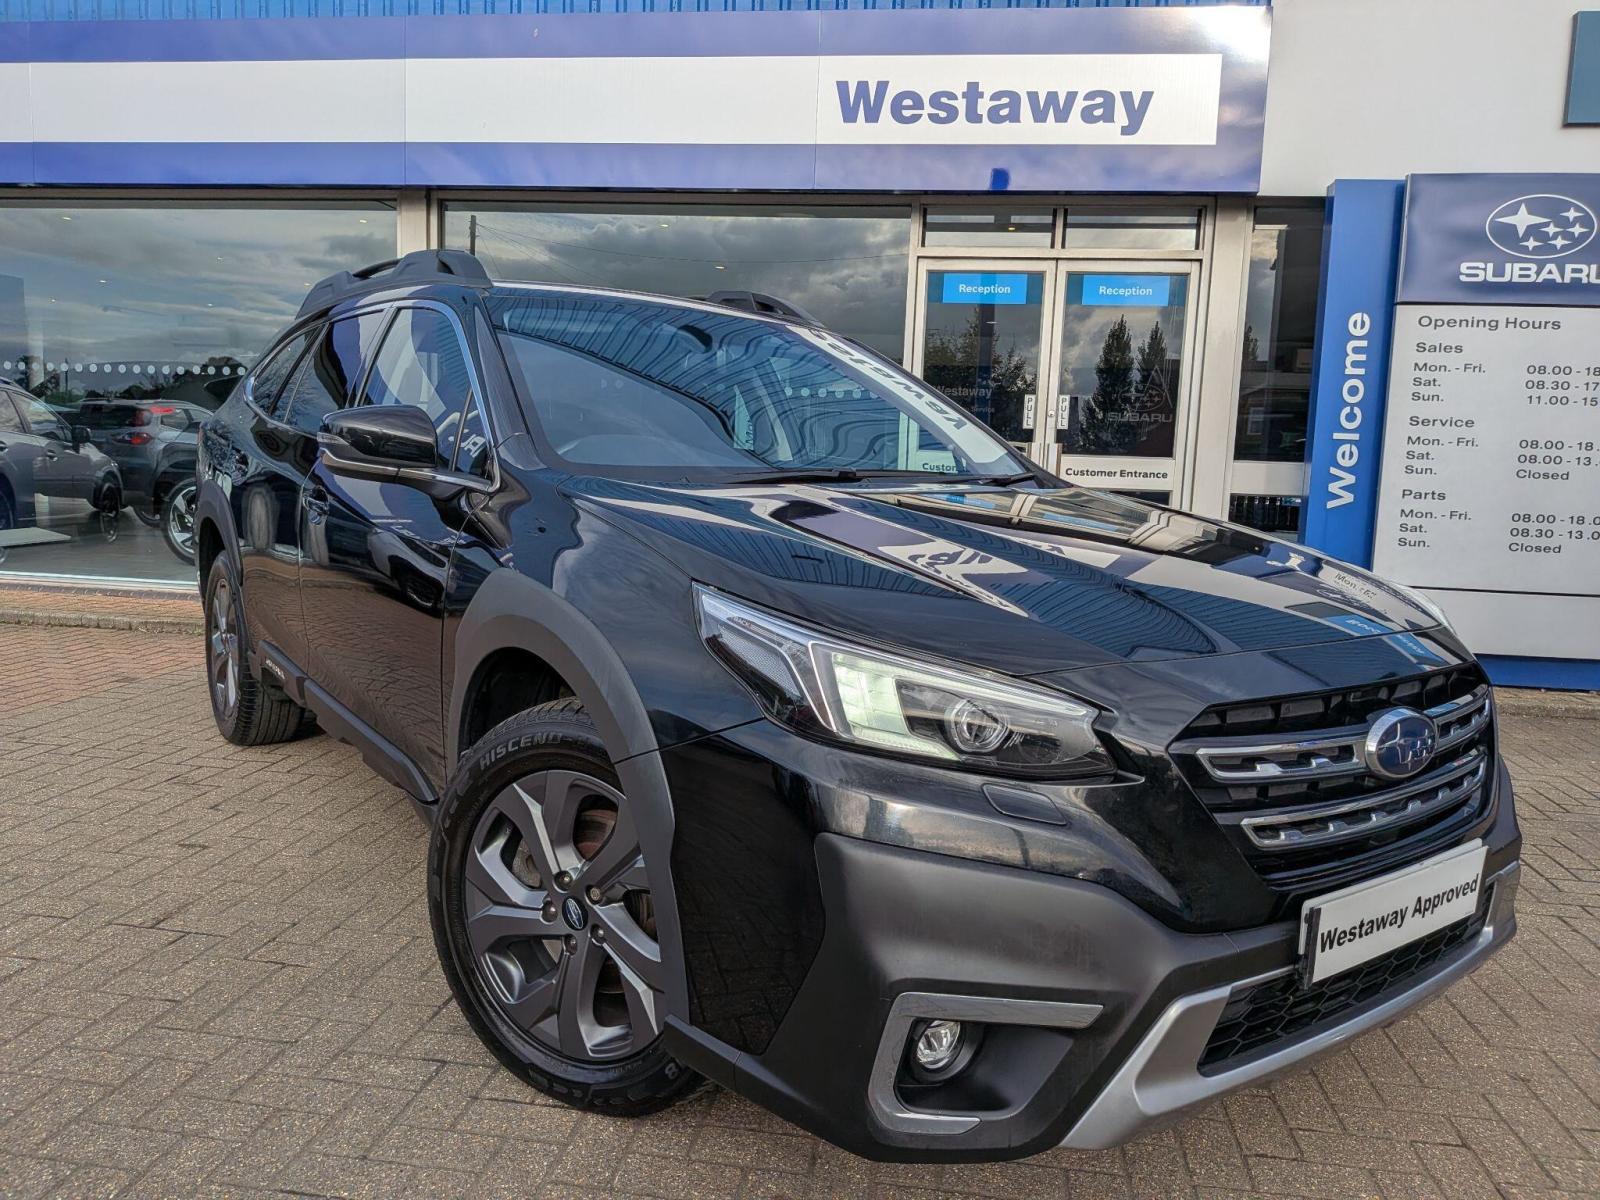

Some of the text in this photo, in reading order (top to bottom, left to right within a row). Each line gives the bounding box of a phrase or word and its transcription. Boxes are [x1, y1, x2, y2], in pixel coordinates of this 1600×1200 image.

[835, 80, 1155, 136] Westaway
[958, 283, 1011, 295] Reception
[1099, 286, 1153, 298] Reception
[1417, 315, 1562, 332] Opening Hours
[1415, 341, 1464, 354] Sales
[1413, 362, 1452, 374] Mon.
[1463, 363, 1486, 375] Fri.
[1526, 364, 1573, 377] 08.00
[1412, 376, 1441, 388] Sat.
[1525, 379, 1571, 392] 08.30
[1411, 391, 1444, 402] Sun.
[1527, 394, 1570, 407] 11.00
[1026, 397, 1034, 427] PULL
[1060, 397, 1069, 427] PULL
[1107, 411, 1174, 423] SUBARU
[1327, 312, 1371, 509] Welcome
[1408, 415, 1475, 429] Service
[1406, 435, 1445, 448] Mon.
[1456, 437, 1479, 449] Fri.
[1518, 439, 1565, 451] 08.00
[1405, 450, 1435, 462] Sat.
[1517, 453, 1563, 466] 08.00
[1065, 467, 1169, 480] Customer Entrance
[1404, 464, 1570, 482] Sun. Closed
[1401, 488, 1447, 502] Parts
[1399, 508, 1438, 520] Mon.
[1449, 510, 1472, 521] Fri.
[1511, 512, 1557, 525] 08.00
[1399, 522, 1428, 534] Sat.
[1509, 527, 1554, 540] 08.30
[1397, 537, 1562, 555] Sun. Closed
[1320, 873, 1480, 954] Westaway Approved
